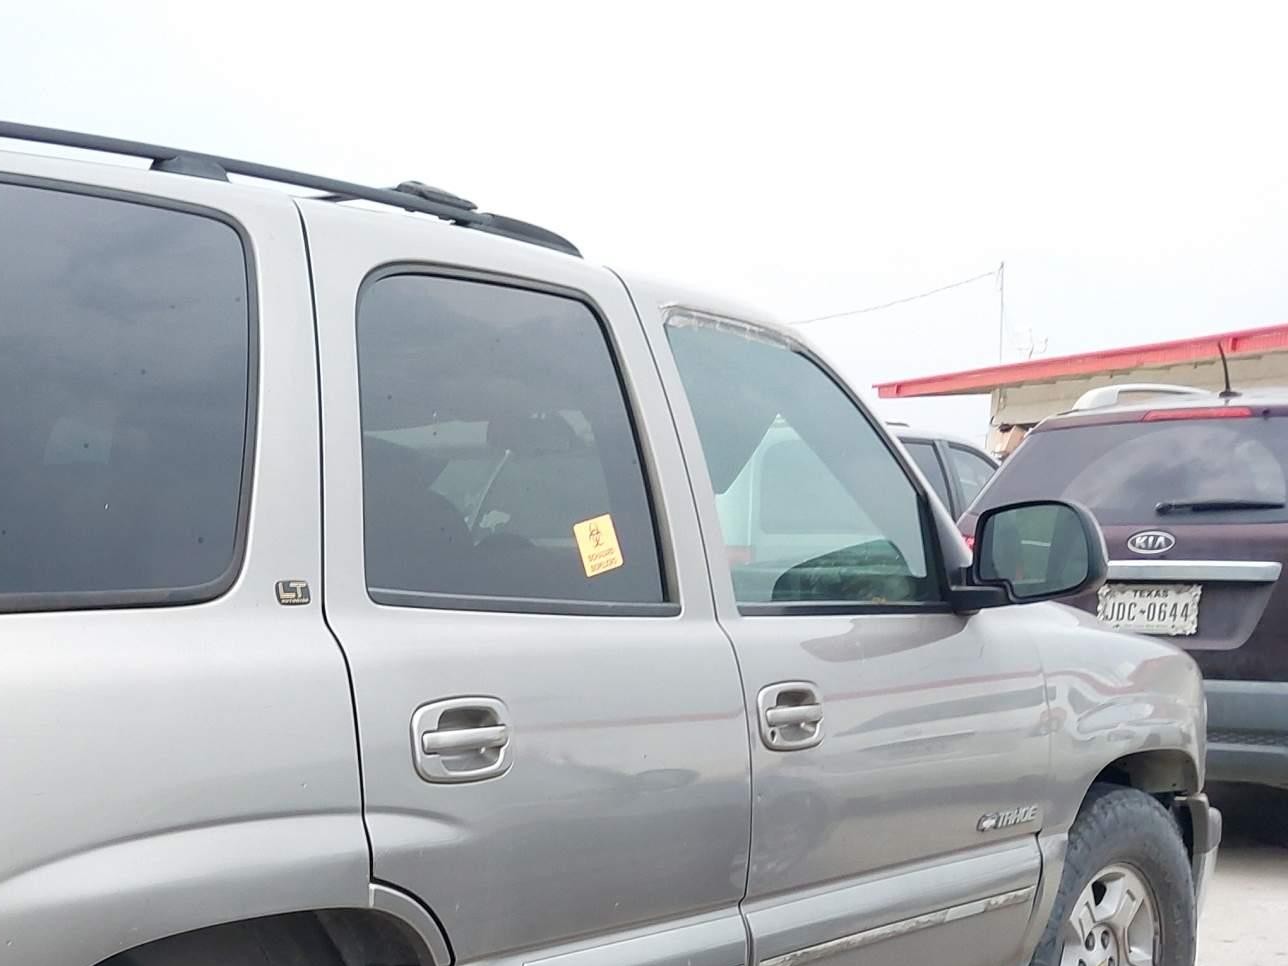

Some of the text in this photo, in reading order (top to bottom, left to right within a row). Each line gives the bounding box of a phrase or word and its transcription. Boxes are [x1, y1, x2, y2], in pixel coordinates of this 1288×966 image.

[1135, 535, 1166, 549] KIA
[278, 582, 307, 599] LT
[1132, 589, 1169, 599] TEXAS
[996, 805, 1039, 829] TAHOE
